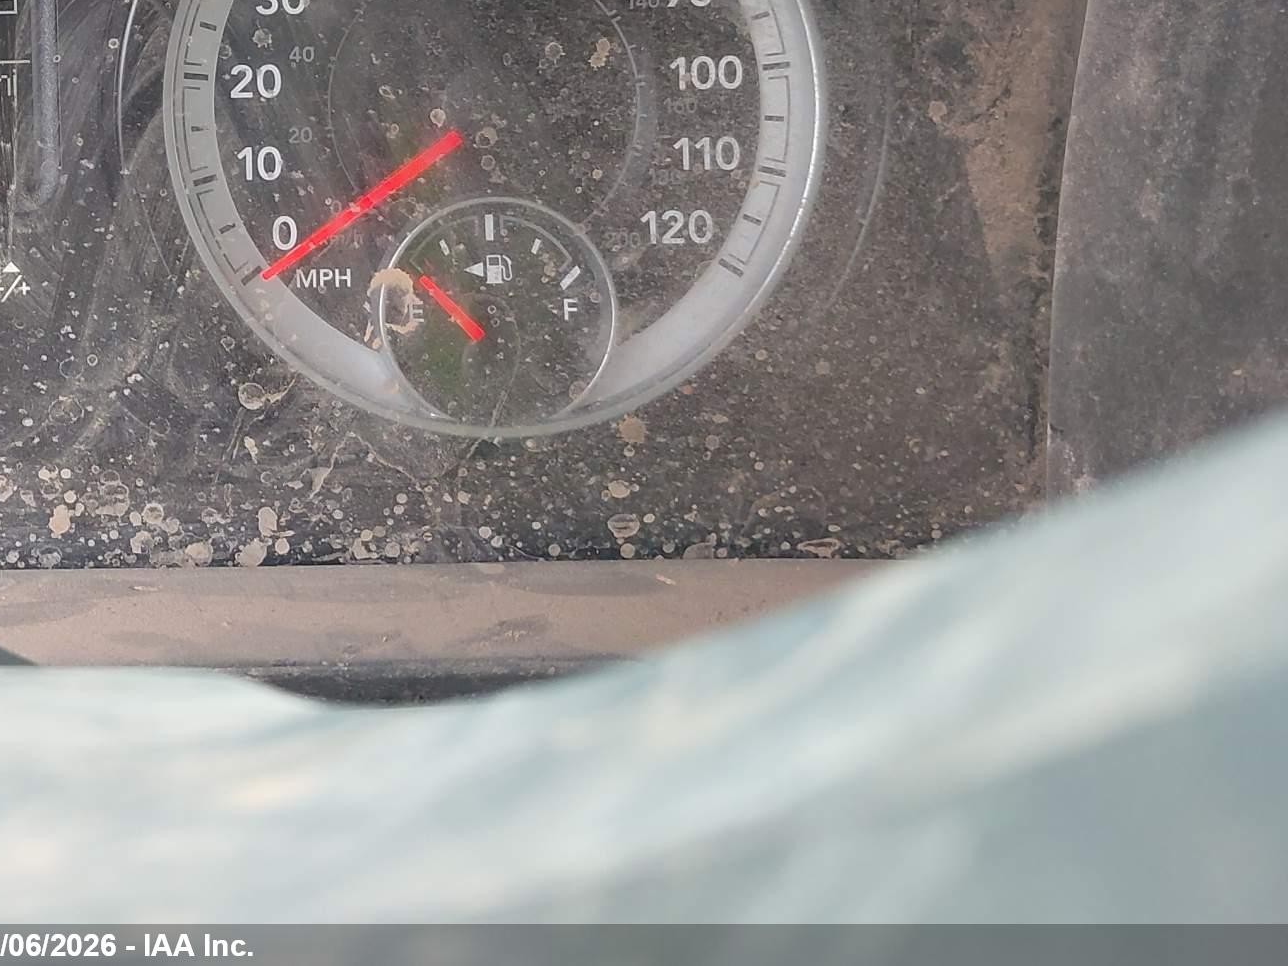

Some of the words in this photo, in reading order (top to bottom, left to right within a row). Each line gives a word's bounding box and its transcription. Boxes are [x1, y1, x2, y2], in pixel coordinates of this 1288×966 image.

[288, 46, 315, 63] 40
[230, 64, 281, 99] 20
[670, 55, 743, 91] 100
[288, 127, 314, 144] 20
[237, 147, 282, 181] 10
[673, 136, 740, 171] 110
[272, 215, 298, 251] 0
[640, 210, 713, 244] 120
[296, 268, 351, 288] MPH
[564, 298, 579, 321] F
